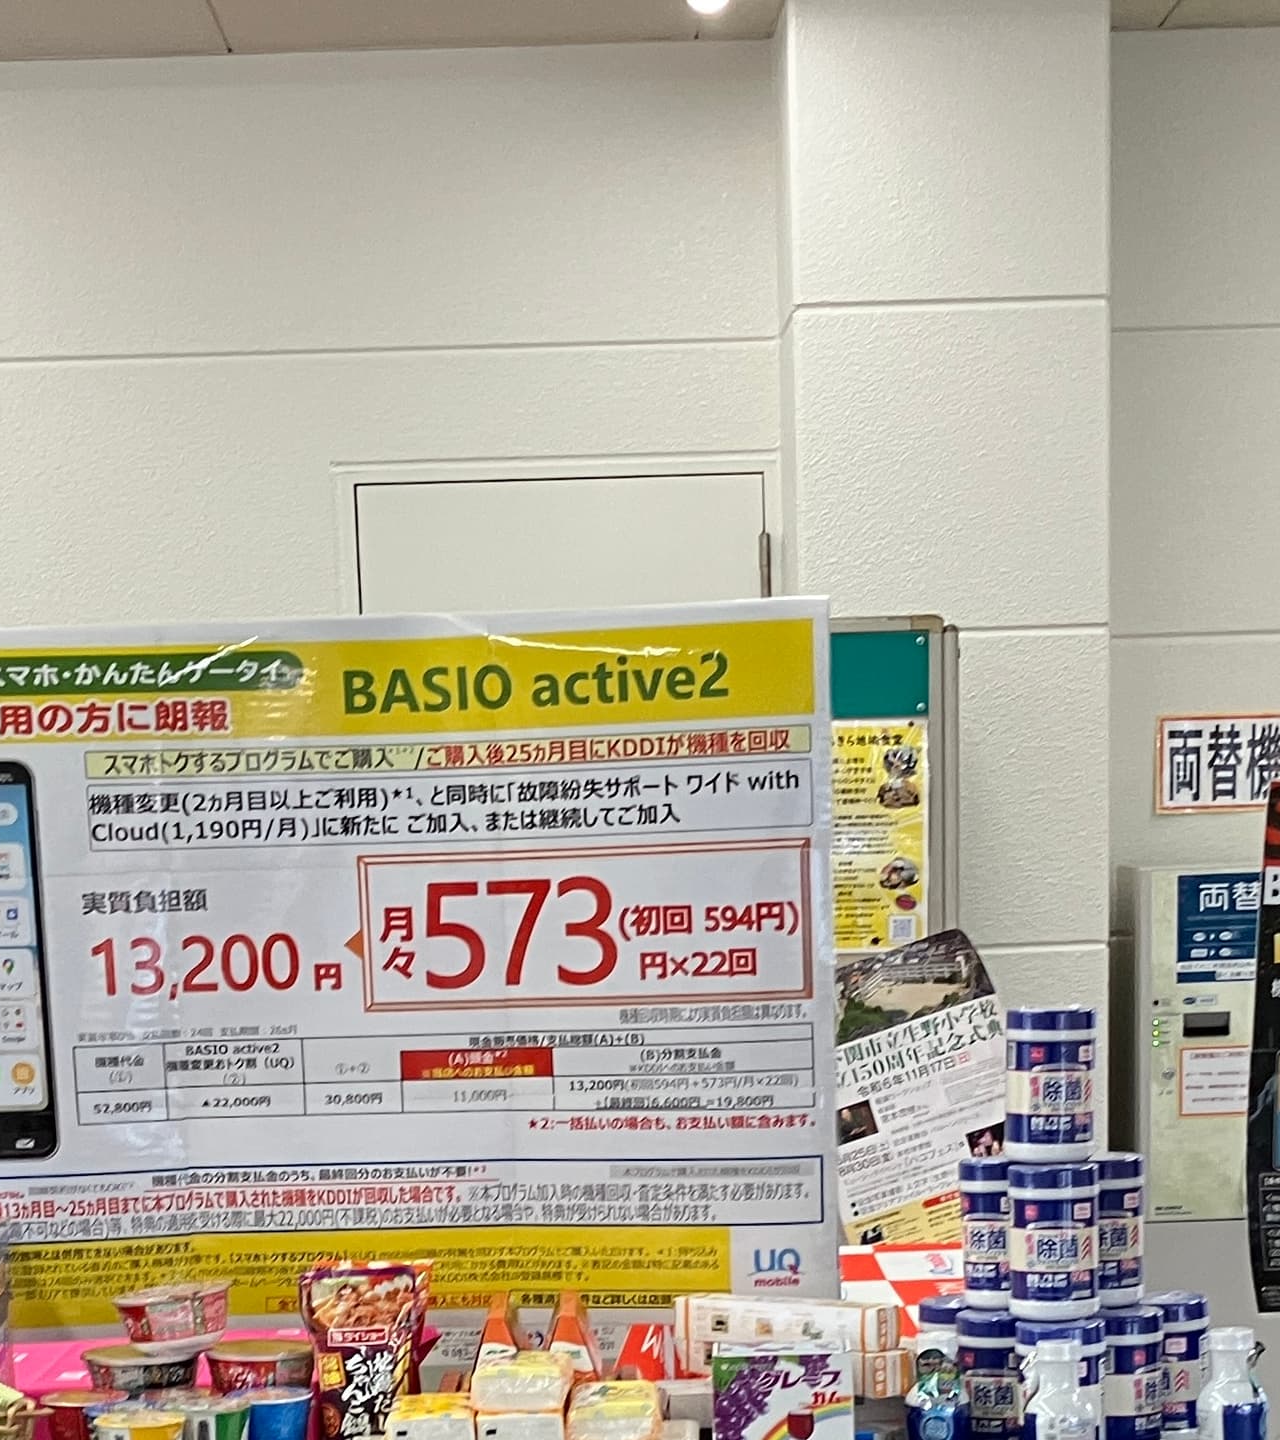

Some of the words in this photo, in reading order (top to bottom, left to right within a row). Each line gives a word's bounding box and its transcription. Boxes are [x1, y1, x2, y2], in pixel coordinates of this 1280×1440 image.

[342, 662, 512, 715] BASIO
[530, 651, 730, 707] active2
[750, 771, 800, 794] with
[80, 888, 209, 916] 実質負担額
[425, 875, 619, 990] 573
[618, 904, 693, 942] (初回
[703, 899, 799, 936] 594円)
[379, 906, 417, 980] 月々
[90, 931, 301, 1002] 13,200
[313, 962, 344, 992] 円
[638, 947, 759, 981] 円×22回
[184, 1045, 229, 1057] BASIO
[232, 1043, 281, 1055] active2
[752, 1246, 802, 1275] UQ
[1036, 1238, 1078, 1261] 除菌
[753, 1275, 801, 1288] mobile
